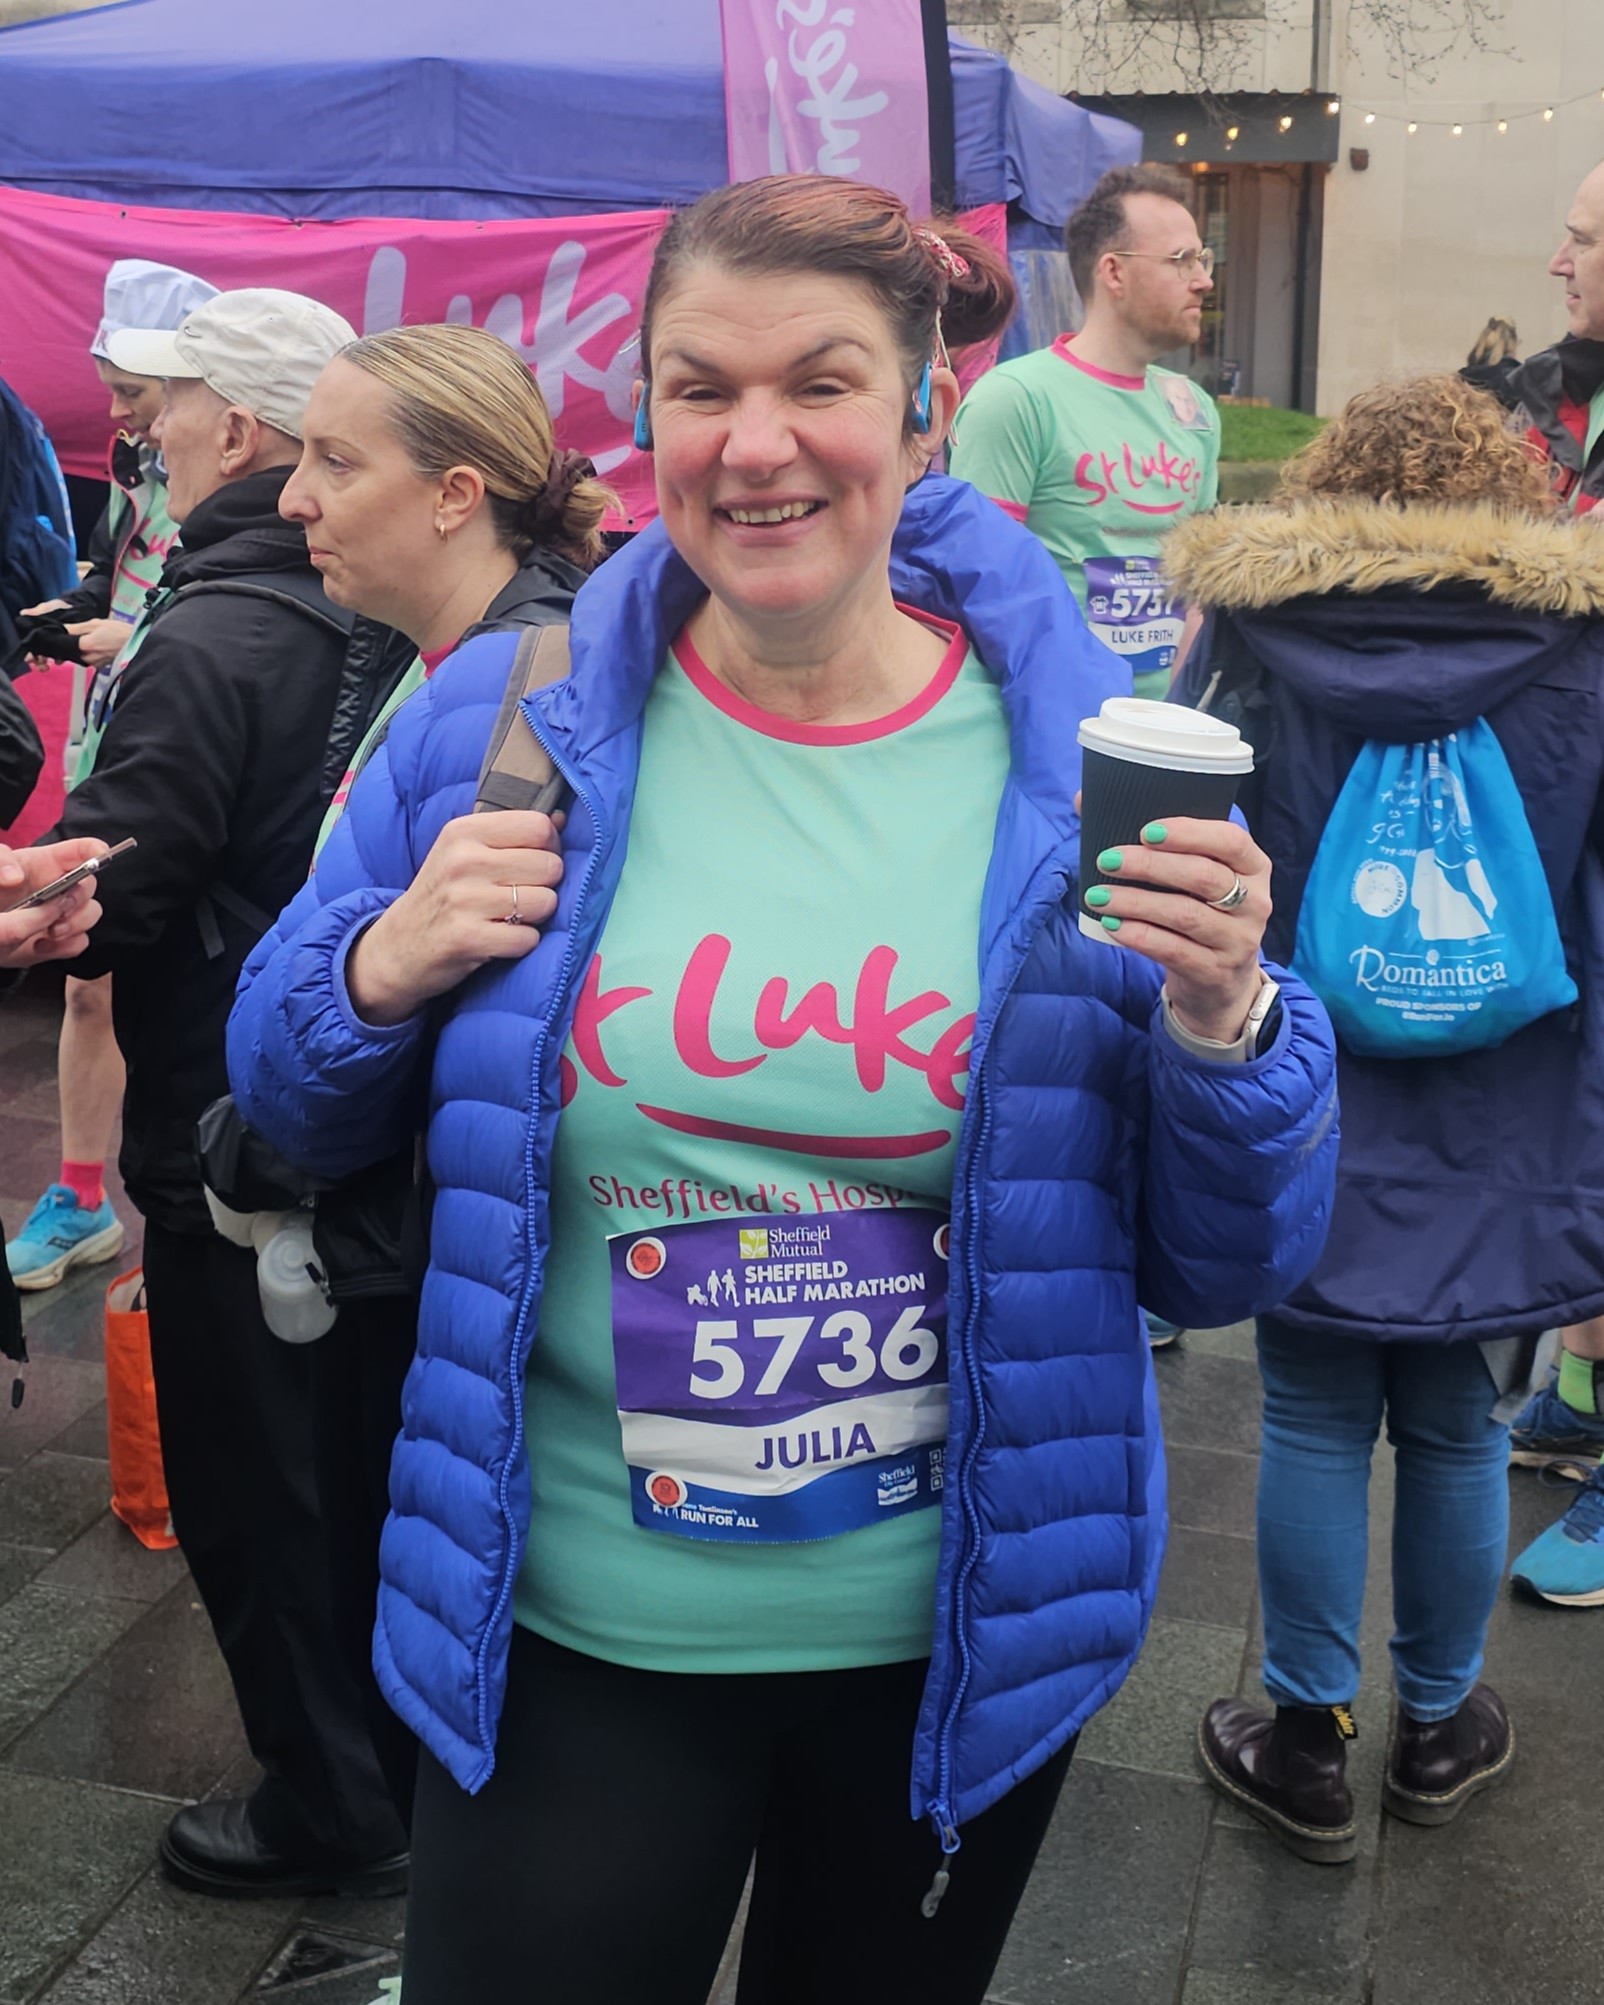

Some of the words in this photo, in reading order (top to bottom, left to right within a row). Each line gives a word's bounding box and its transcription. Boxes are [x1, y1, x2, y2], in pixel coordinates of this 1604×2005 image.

[1111, 631, 1145, 644] LUKE
[1147, 629, 1174, 642] FRITH
[1349, 943, 1508, 992] Romantica
[559, 952, 654, 1111] t
[588, 1175, 801, 1220] Sheffield's
[769, 1225, 831, 1243] Sheffield
[770, 1241, 824, 1259] Mutual
[745, 1261, 849, 1284] SHEFFIELD
[745, 1284, 797, 1305] HALF
[803, 1273, 926, 1302] MARATHON
[689, 1305, 939, 1400] 5736
[755, 1422, 877, 1471] JULIA
[680, 1508, 706, 1524] RUN
[707, 1514, 733, 1526] FOR
[736, 1516, 759, 1528] ALL
